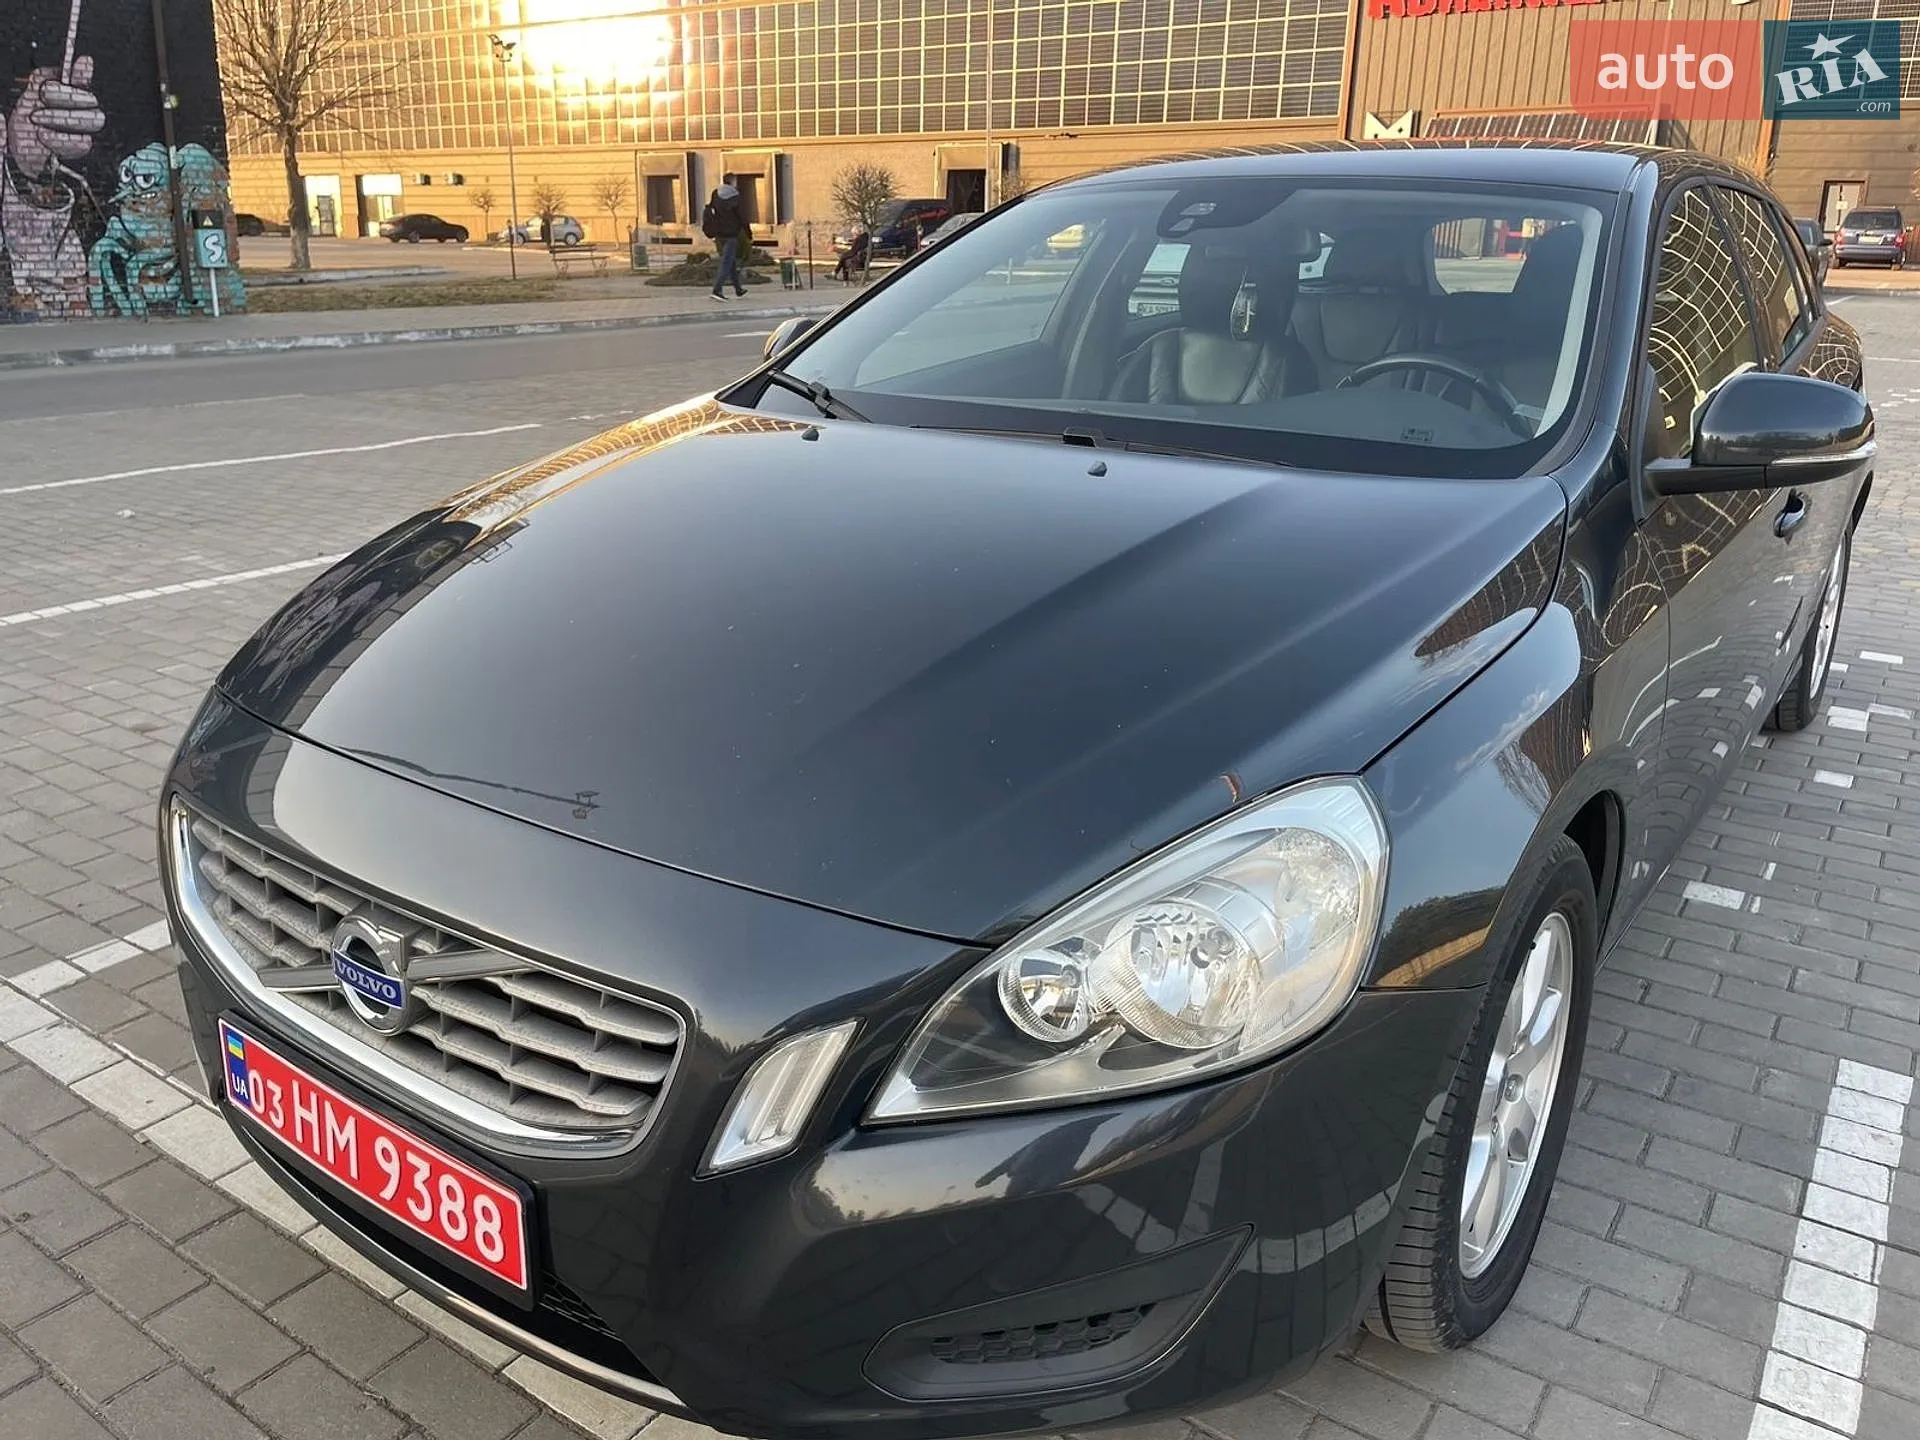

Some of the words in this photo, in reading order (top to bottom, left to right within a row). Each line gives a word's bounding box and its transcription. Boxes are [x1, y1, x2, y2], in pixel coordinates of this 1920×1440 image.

[334, 958, 397, 999] VOLVO
[231, 1073, 249, 1100] UA
[248, 1069, 285, 1129] 03
[291, 1079, 360, 1181] HM
[374, 1136, 504, 1263] 9388
